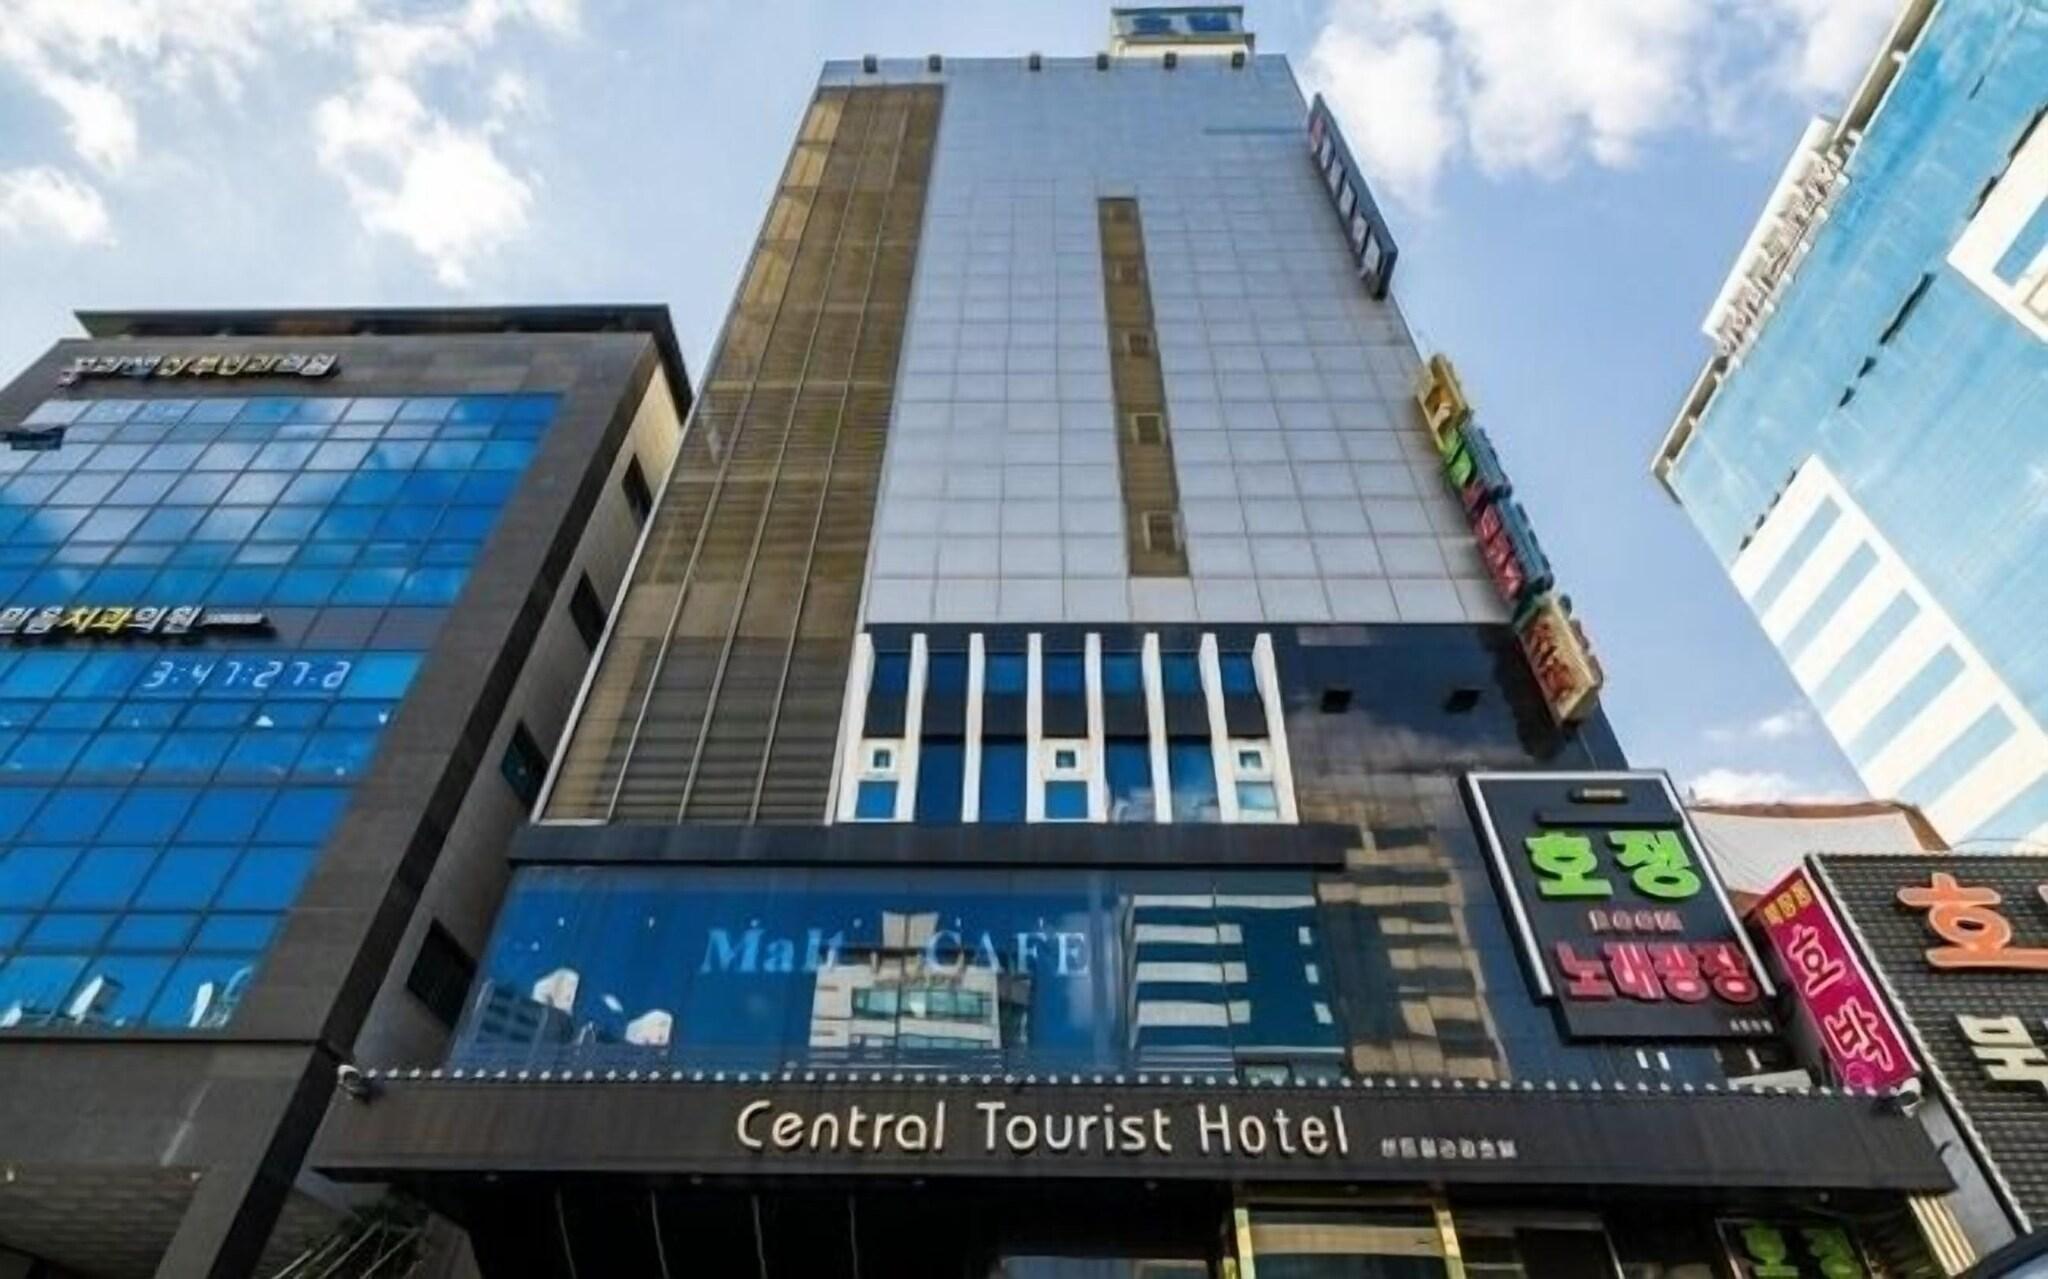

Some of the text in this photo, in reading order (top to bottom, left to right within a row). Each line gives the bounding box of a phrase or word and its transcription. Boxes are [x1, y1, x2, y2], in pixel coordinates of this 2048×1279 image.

[925, 930, 1089, 975] CAFE
[1897, 872, 2048, 968] 호
[1956, 1014, 2048, 1096] 북
[737, 1100, 1349, 1154] Central Tourist Hotel
